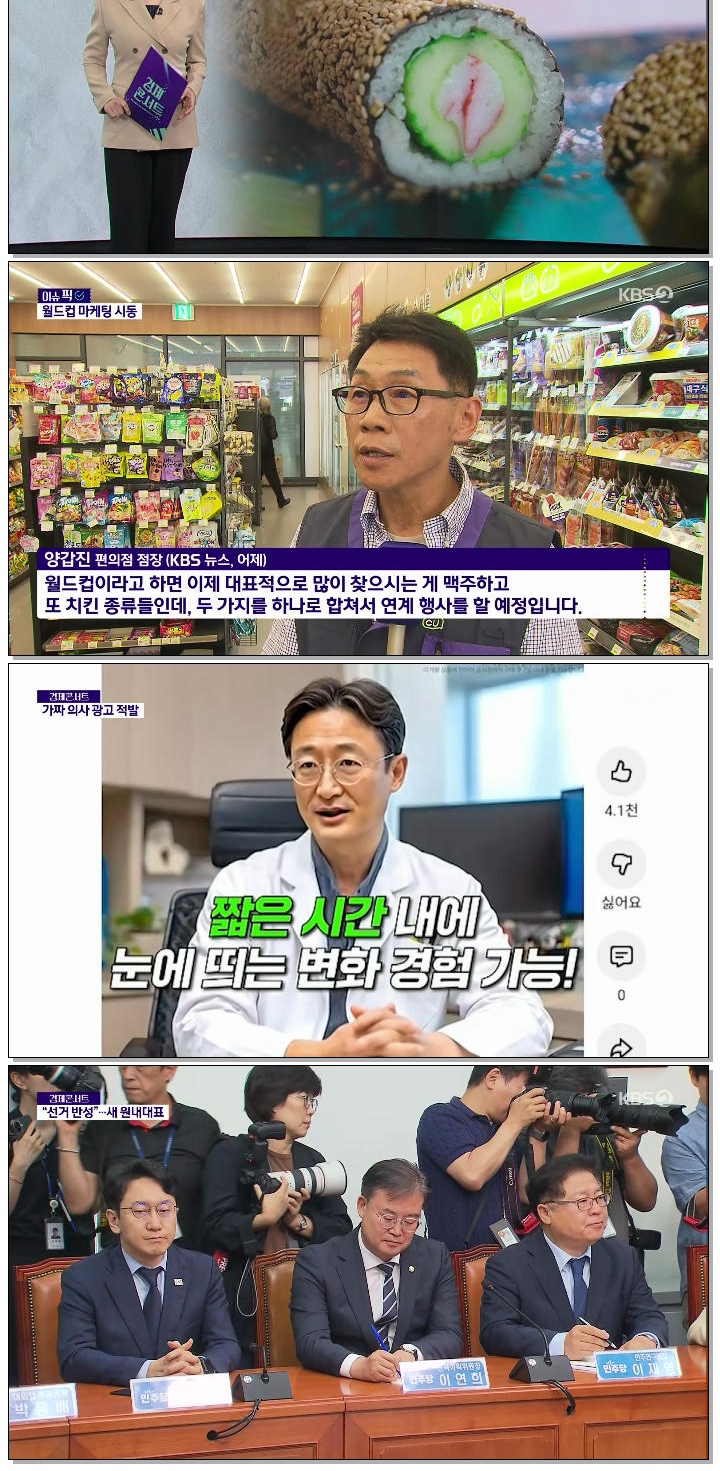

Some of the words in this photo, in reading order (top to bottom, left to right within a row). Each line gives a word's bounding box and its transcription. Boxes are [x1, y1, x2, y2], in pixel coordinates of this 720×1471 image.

[143, 76, 166, 101] 경제
[133, 86, 165, 118] 콘서트
[604, 802, 639, 818] 4.1천
[602, 895, 642, 910] 싫어요
[209, 896, 294, 938] 짧은
[301, 896, 388, 938] 시간
[396, 896, 479, 939] 내에
[110, 948, 195, 990] 눈에
[201, 947, 287, 990] 띄는
[297, 947, 382, 990] 변화
[390, 947, 472, 990] 경험
[480, 947, 579, 990] 가능!
[617, 988, 627, 1002] 0
[602, 1362, 628, 1374] 민주당
[409, 1373, 434, 1385] 민주당
